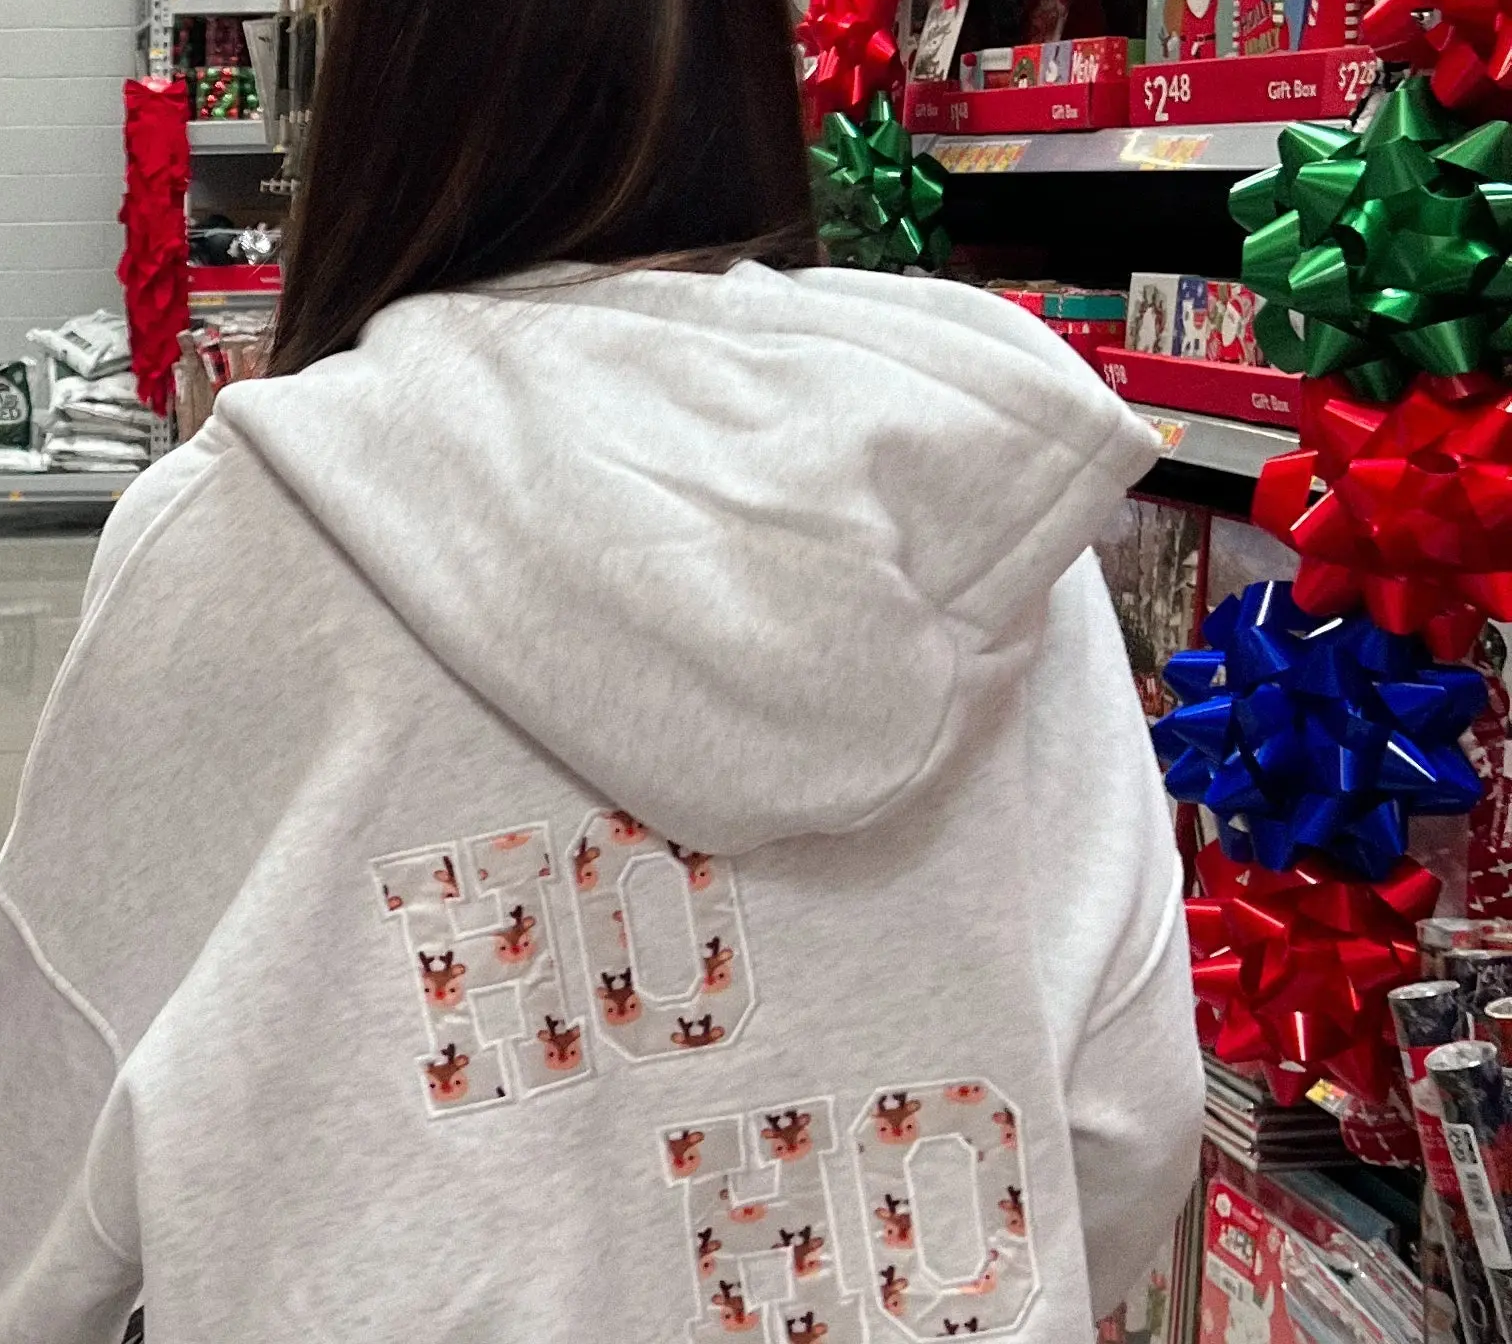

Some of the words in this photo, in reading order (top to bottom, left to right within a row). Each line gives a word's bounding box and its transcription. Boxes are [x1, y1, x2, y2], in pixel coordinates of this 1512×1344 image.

[1267, 79, 1292, 100] Gift
[1293, 78, 1318, 99] Box
[368, 806, 763, 1119] HO
